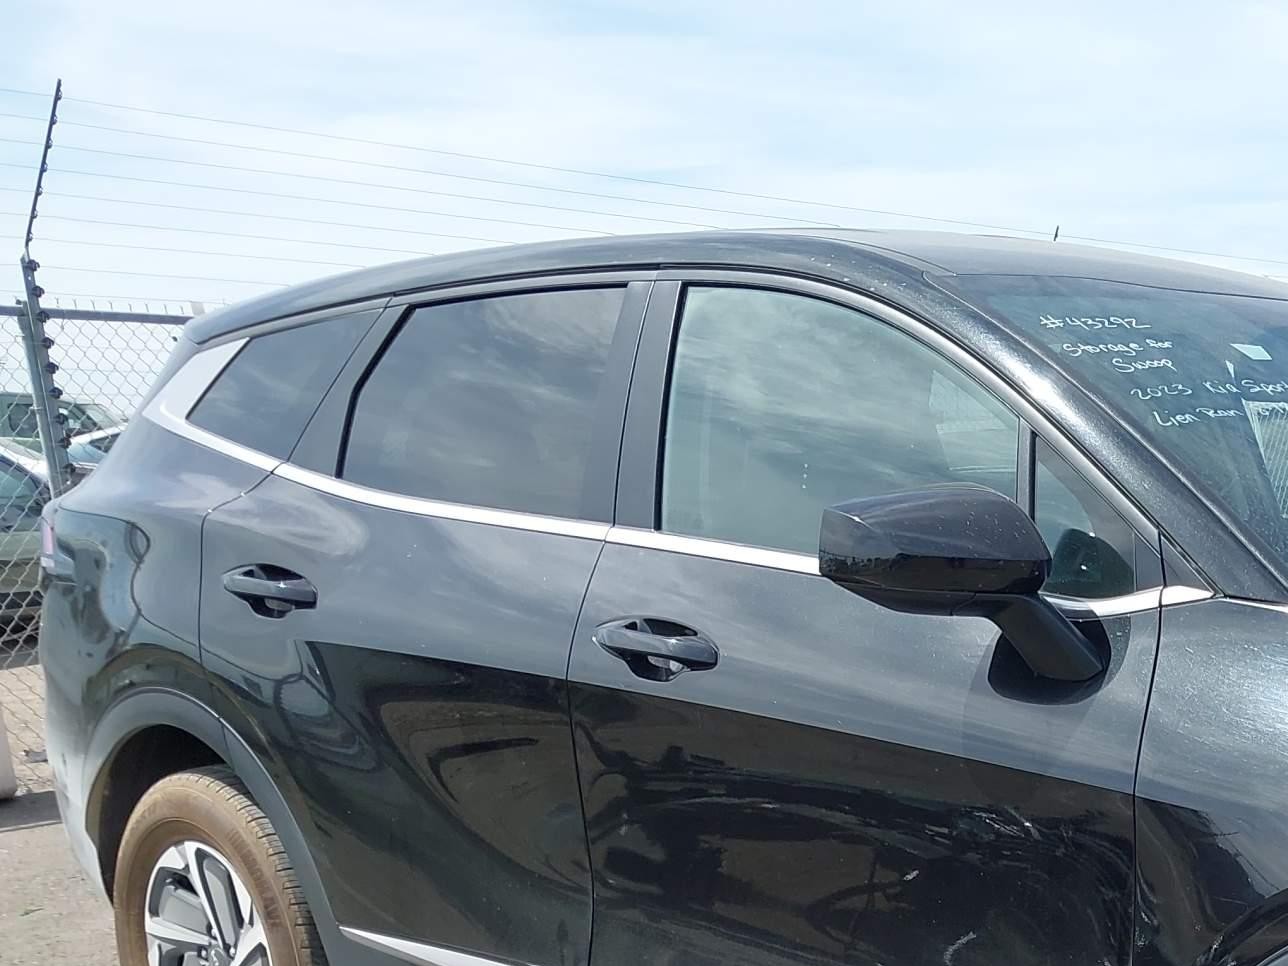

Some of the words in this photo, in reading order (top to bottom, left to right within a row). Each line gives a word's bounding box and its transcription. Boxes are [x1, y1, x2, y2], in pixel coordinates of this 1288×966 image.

[1040, 315, 1152, 330] #43292
[1063, 343, 1143, 356] Storage
[1112, 358, 1177, 372] Swoop
[1130, 383, 1193, 400] 2023
[1203, 380, 1241, 395] Kia
[1153, 410, 1200, 426] Lien
